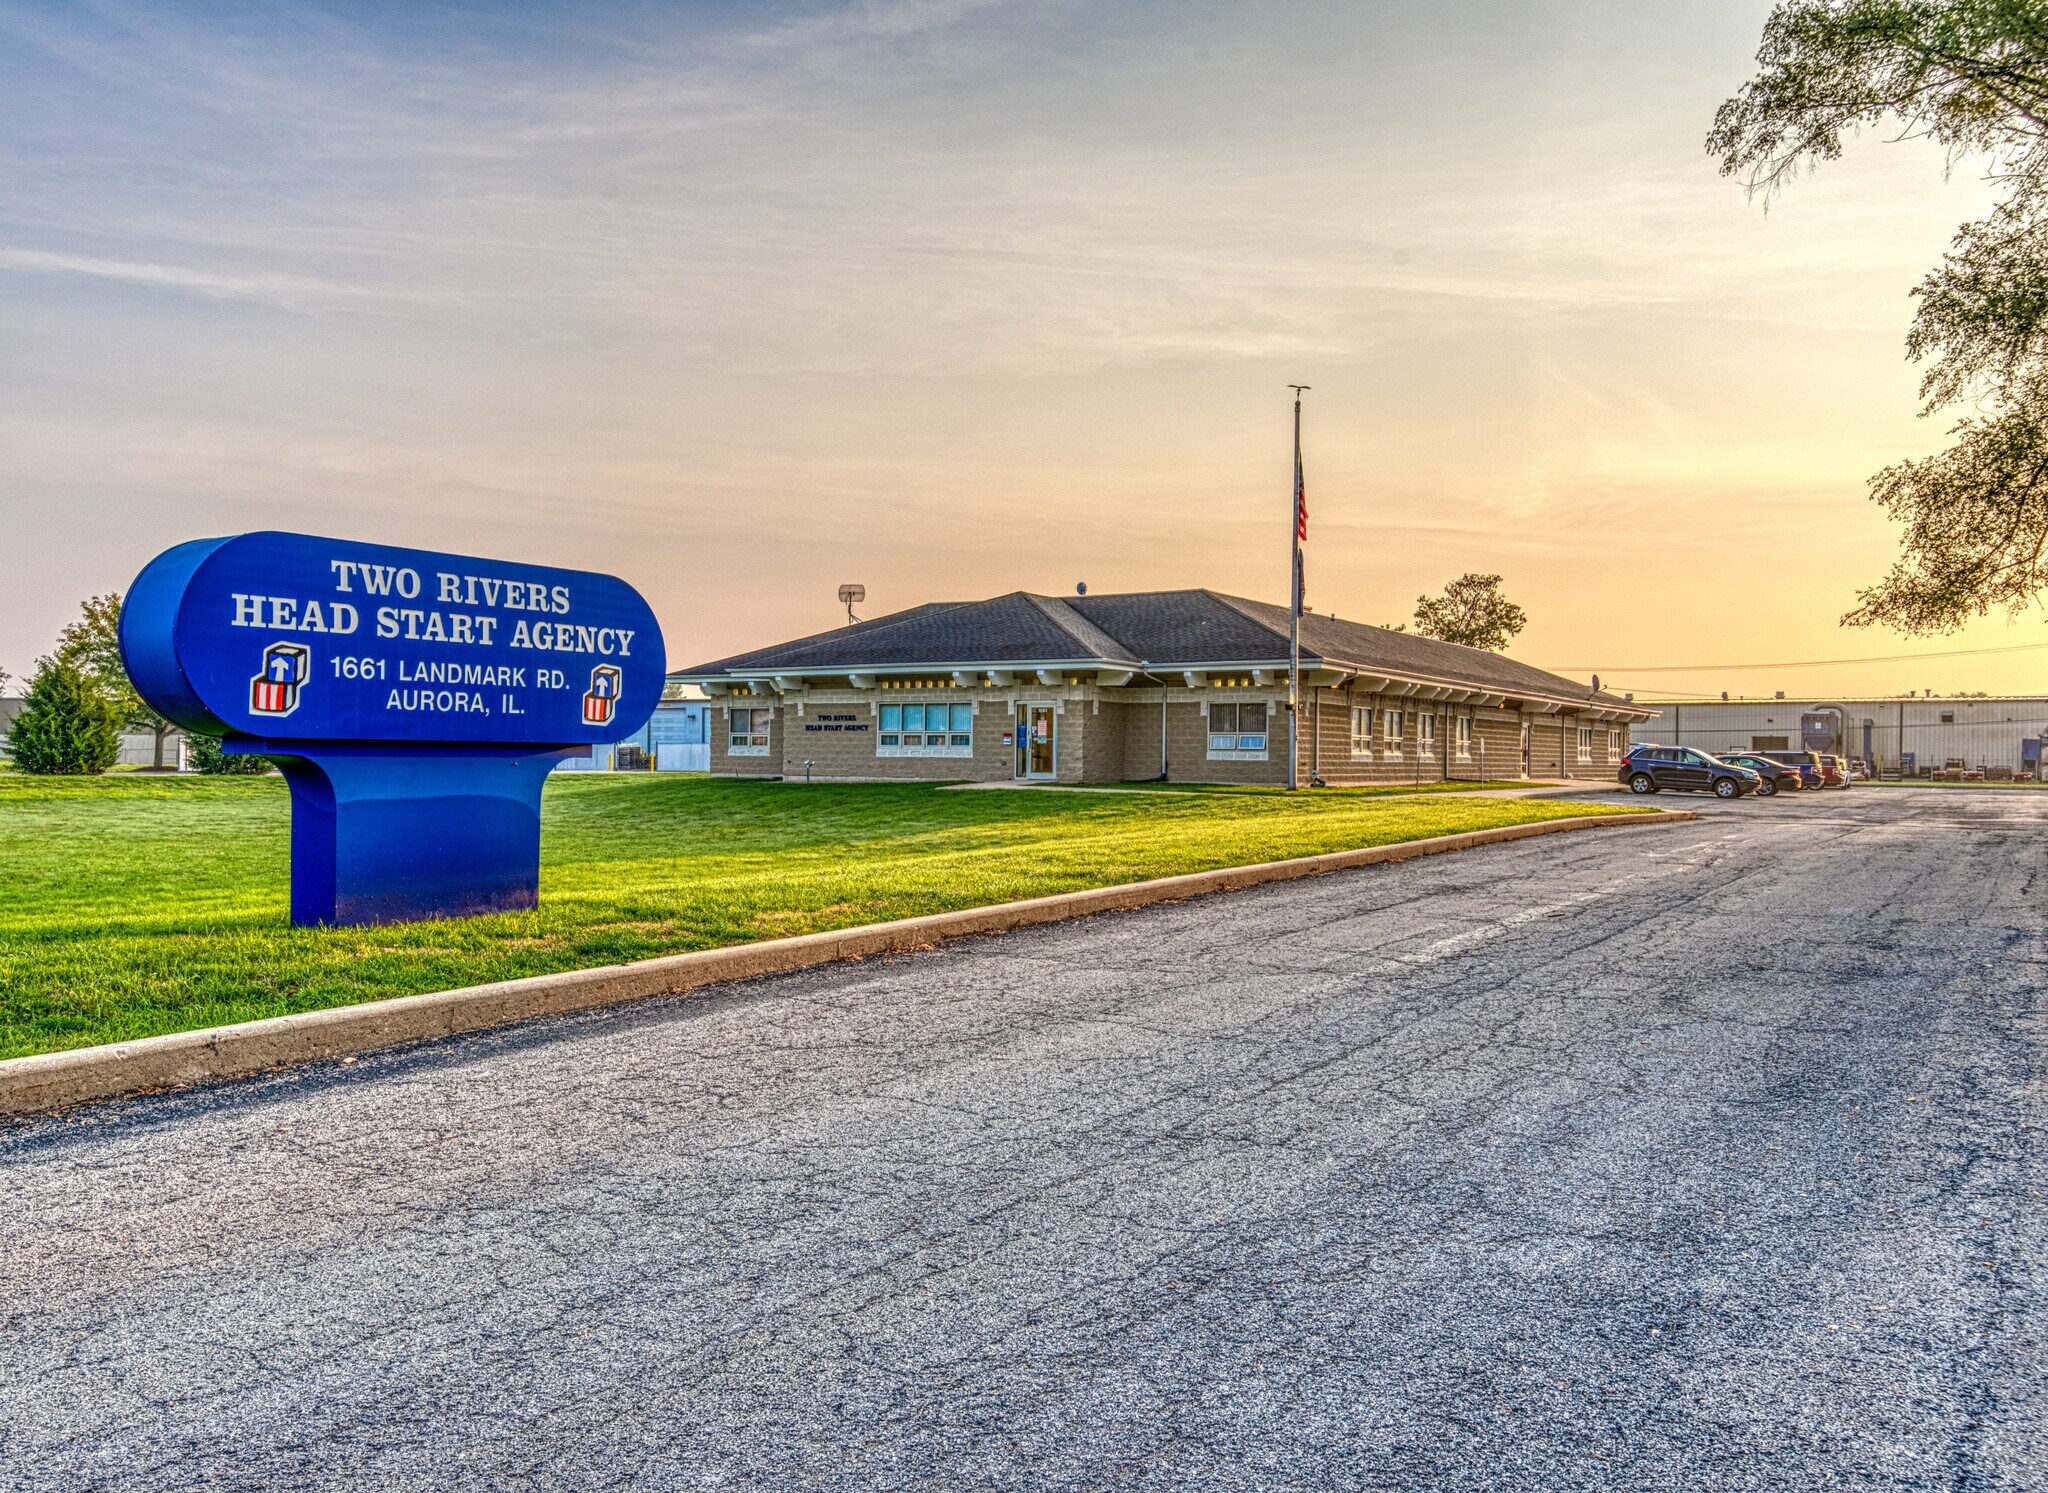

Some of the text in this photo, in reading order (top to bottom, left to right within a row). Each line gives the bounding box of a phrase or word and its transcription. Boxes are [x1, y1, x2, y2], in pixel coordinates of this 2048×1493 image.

[331, 560, 570, 614] TWO RIVERS
[231, 593, 635, 656] HEAD START AGENCY
[330, 656, 570, 690] 1661 LANDMARK RD.
[386, 689, 525, 717] AURORA, IL.
